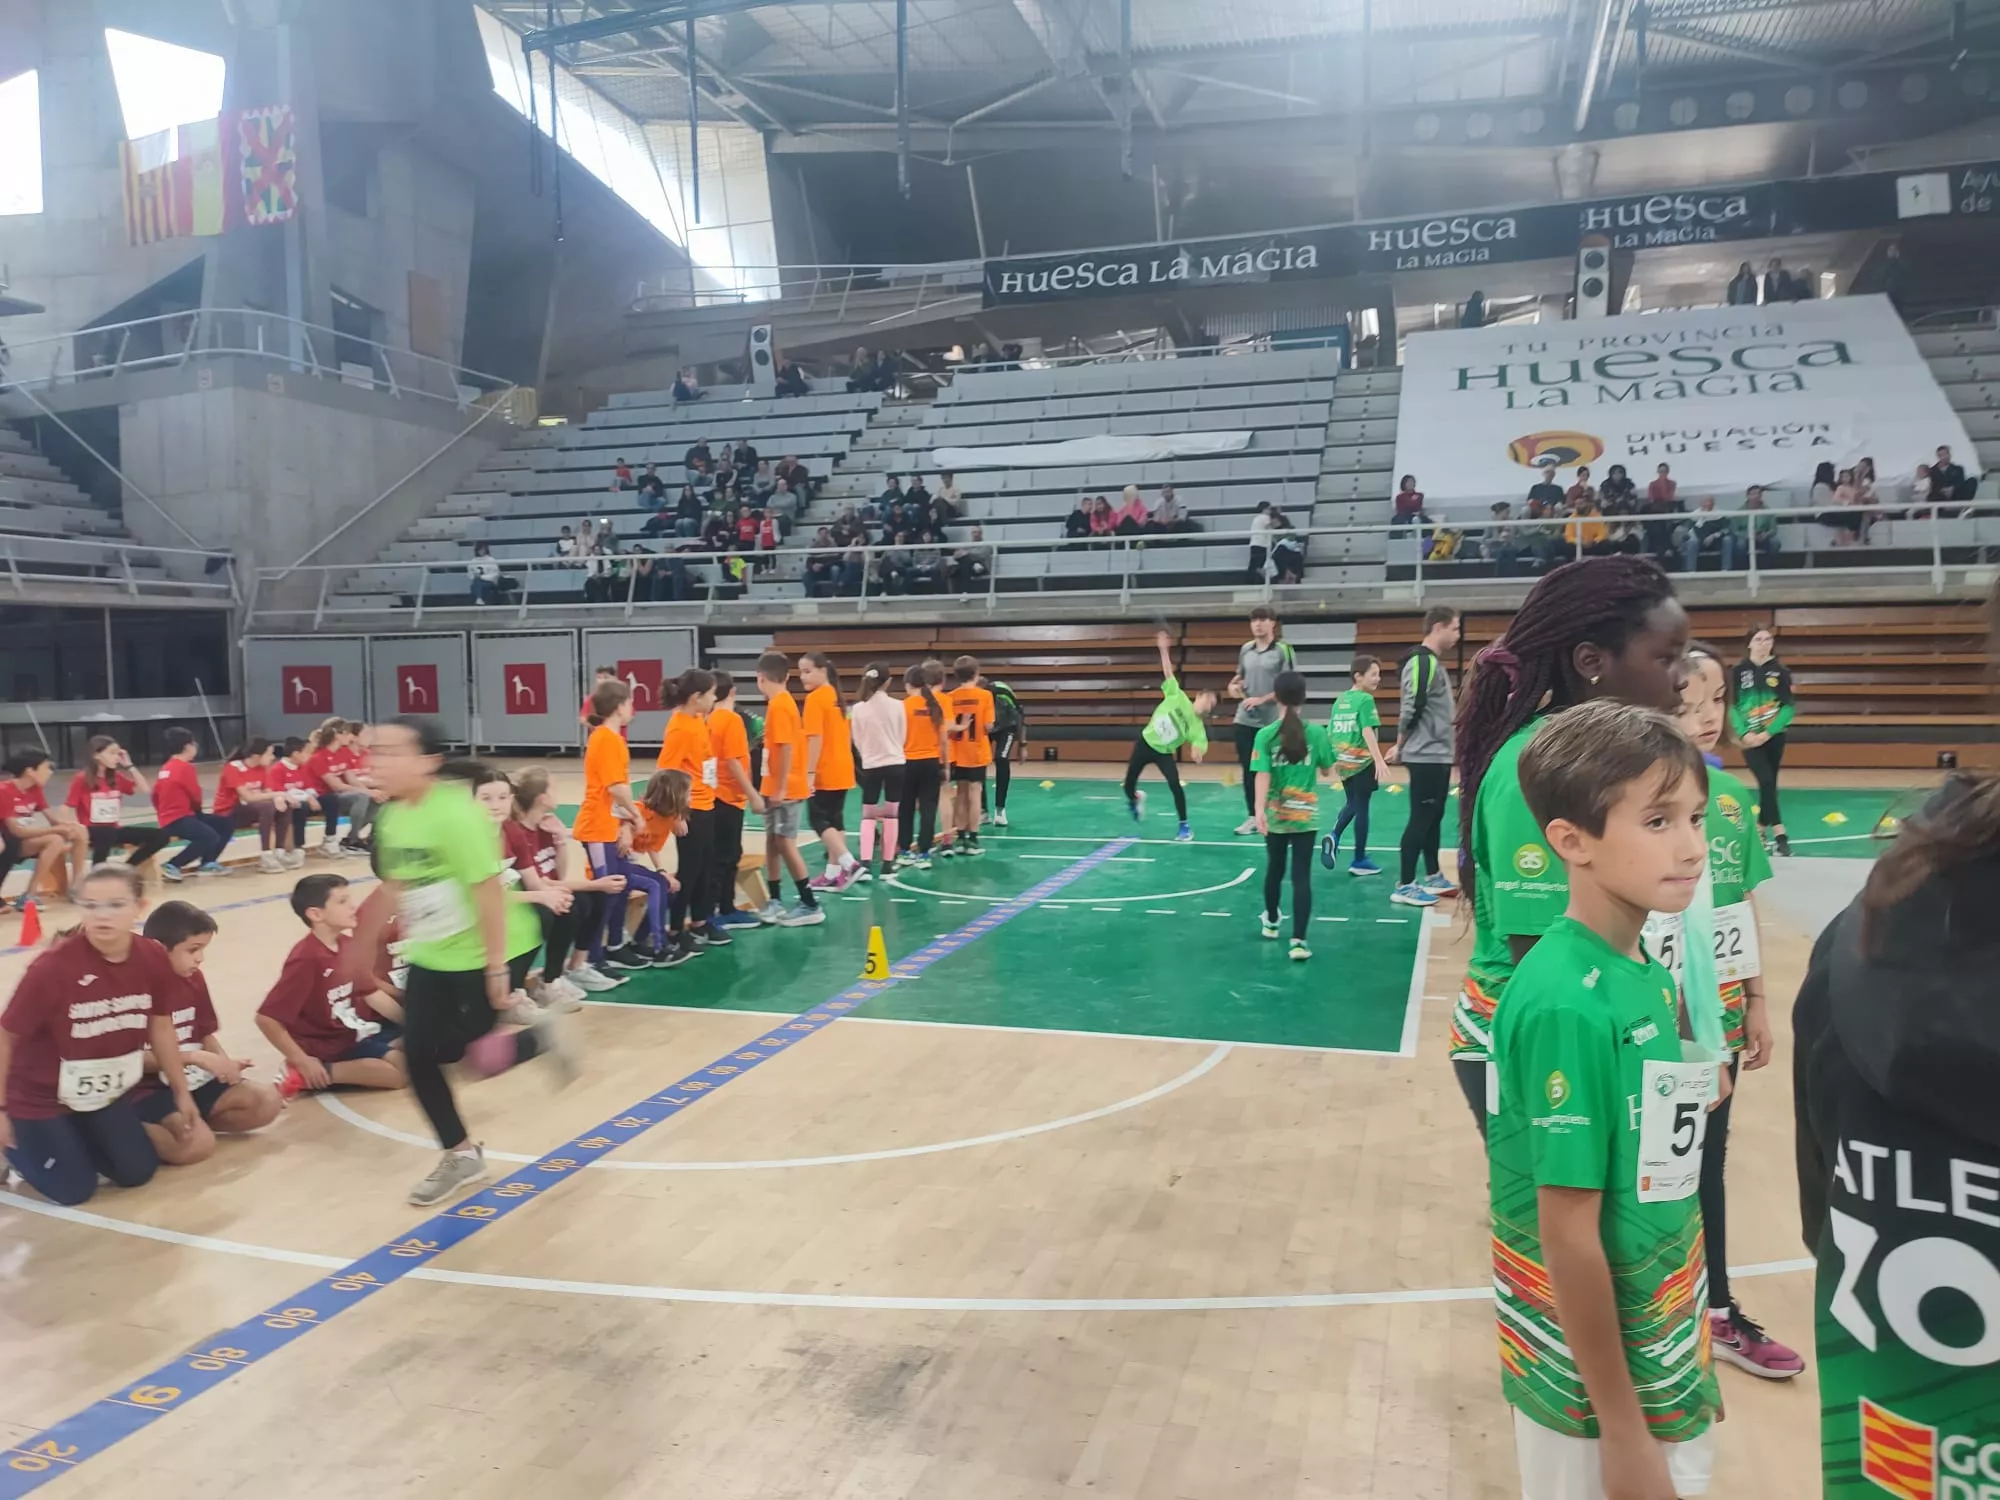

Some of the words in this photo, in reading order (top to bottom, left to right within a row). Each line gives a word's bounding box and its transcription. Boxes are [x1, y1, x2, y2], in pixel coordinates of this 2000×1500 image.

[1960, 191, 1993, 213] de
[1367, 217, 1518, 252] Huesca
[999, 262, 1140, 293] Huesca
[1450, 339, 1864, 392] Huesca
[1627, 435, 1834, 457] HUESCA
[865, 951, 877, 975] 5
[76, 1070, 126, 1096] 531
[1671, 1103, 1705, 1157] 5
[1833, 1136, 2000, 1228] ATLE
[457, 1205, 498, 1217] 8
[390, 1238, 440, 1257] 20
[330, 1271, 378, 1291] 40
[263, 1307, 318, 1329] 60
[189, 1347, 249, 1371] 80
[9, 1439, 80, 1472] 20
